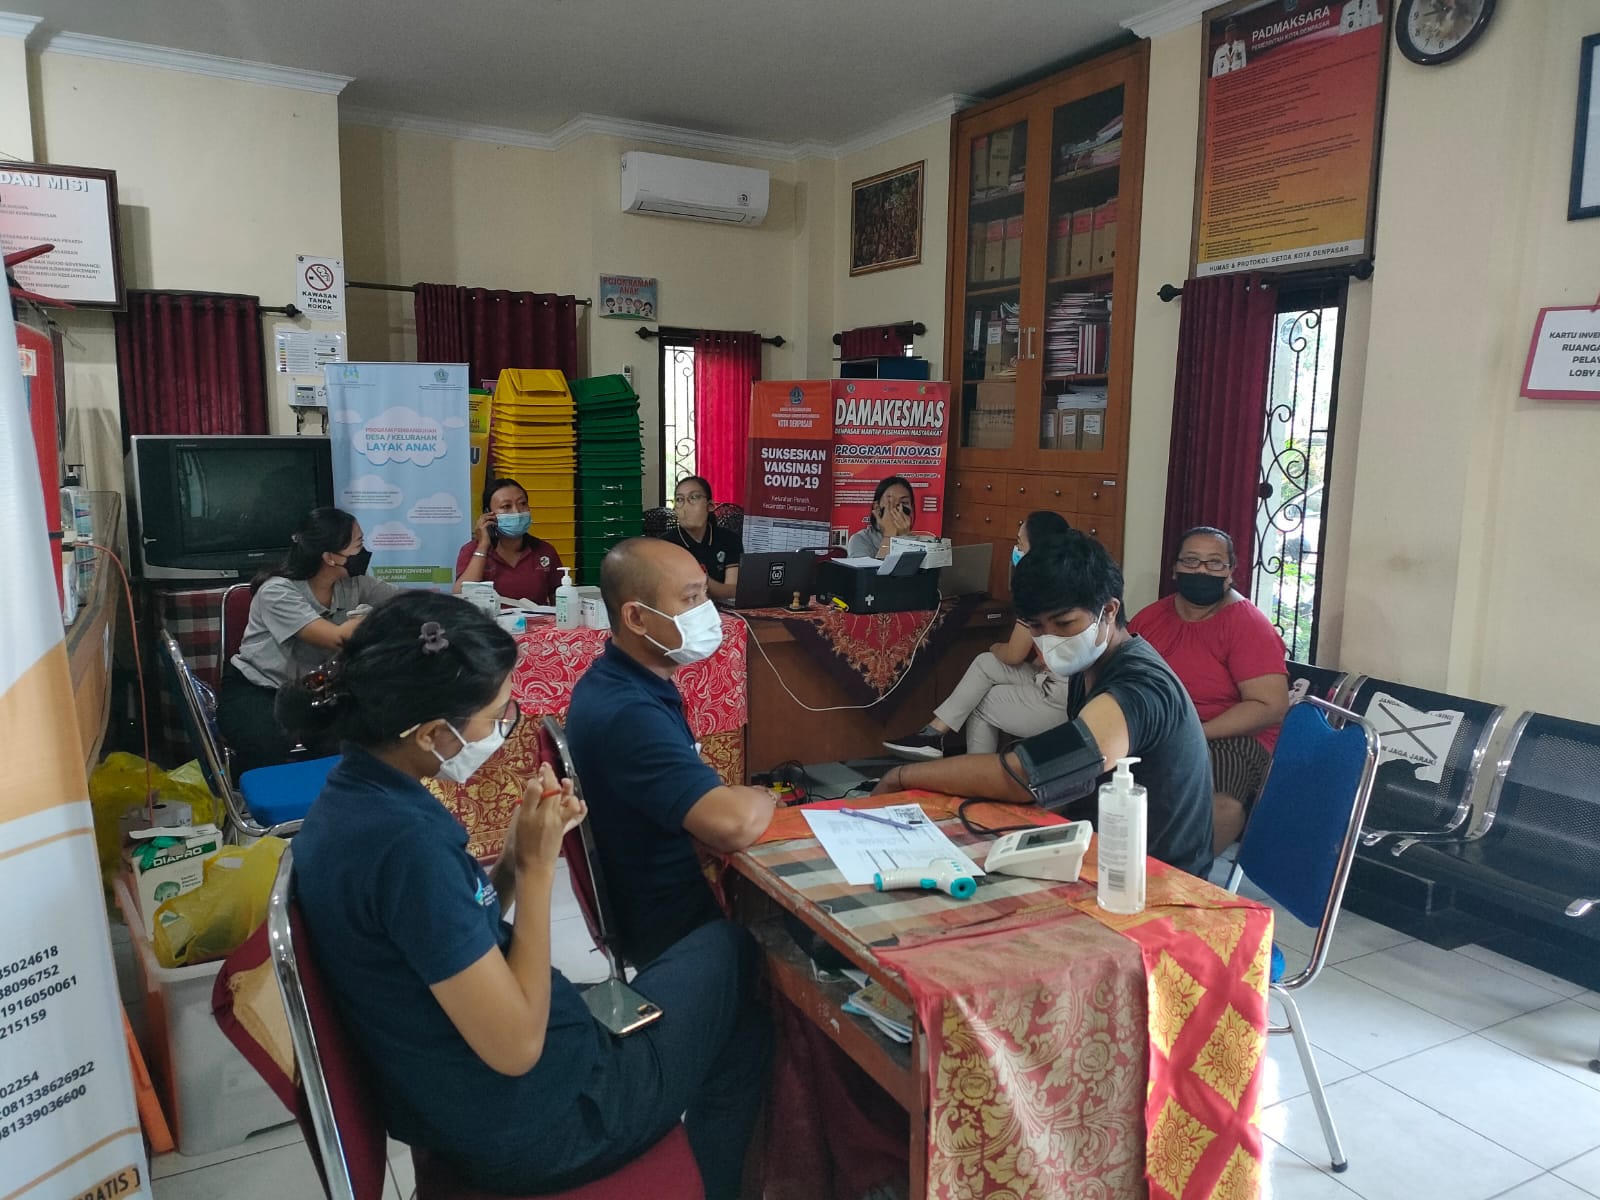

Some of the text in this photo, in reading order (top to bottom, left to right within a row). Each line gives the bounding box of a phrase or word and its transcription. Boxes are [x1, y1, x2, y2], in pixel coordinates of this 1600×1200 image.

[1252, 6, 1330, 42] PADMAKSARA
[0, 172, 89, 193] DAN MISI
[1210, 263, 1230, 273] HUMAS
[1237, 257, 1270, 268] PROTOKOL
[1294, 252, 1311, 260] KOTA
[1313, 245, 1350, 257] DENPASAR
[302, 291, 338, 300] KAWASAN
[307, 303, 333, 311] ROKOK
[1550, 331, 1577, 339] KARTU
[1569, 369, 1595, 377] LOBY
[835, 398, 945, 429] DAMAKESMAS
[365, 433, 386, 441] DESA
[366, 442, 437, 452] LAYAK ANAK
[835, 445, 942, 457] PROGRAM INOVASI
[761, 447, 827, 461] SUKSESKAN
[764, 461, 822, 475] VAKSINASI
[764, 474, 820, 490] COVID-19
[1388, 747, 1408, 758] JAGA
